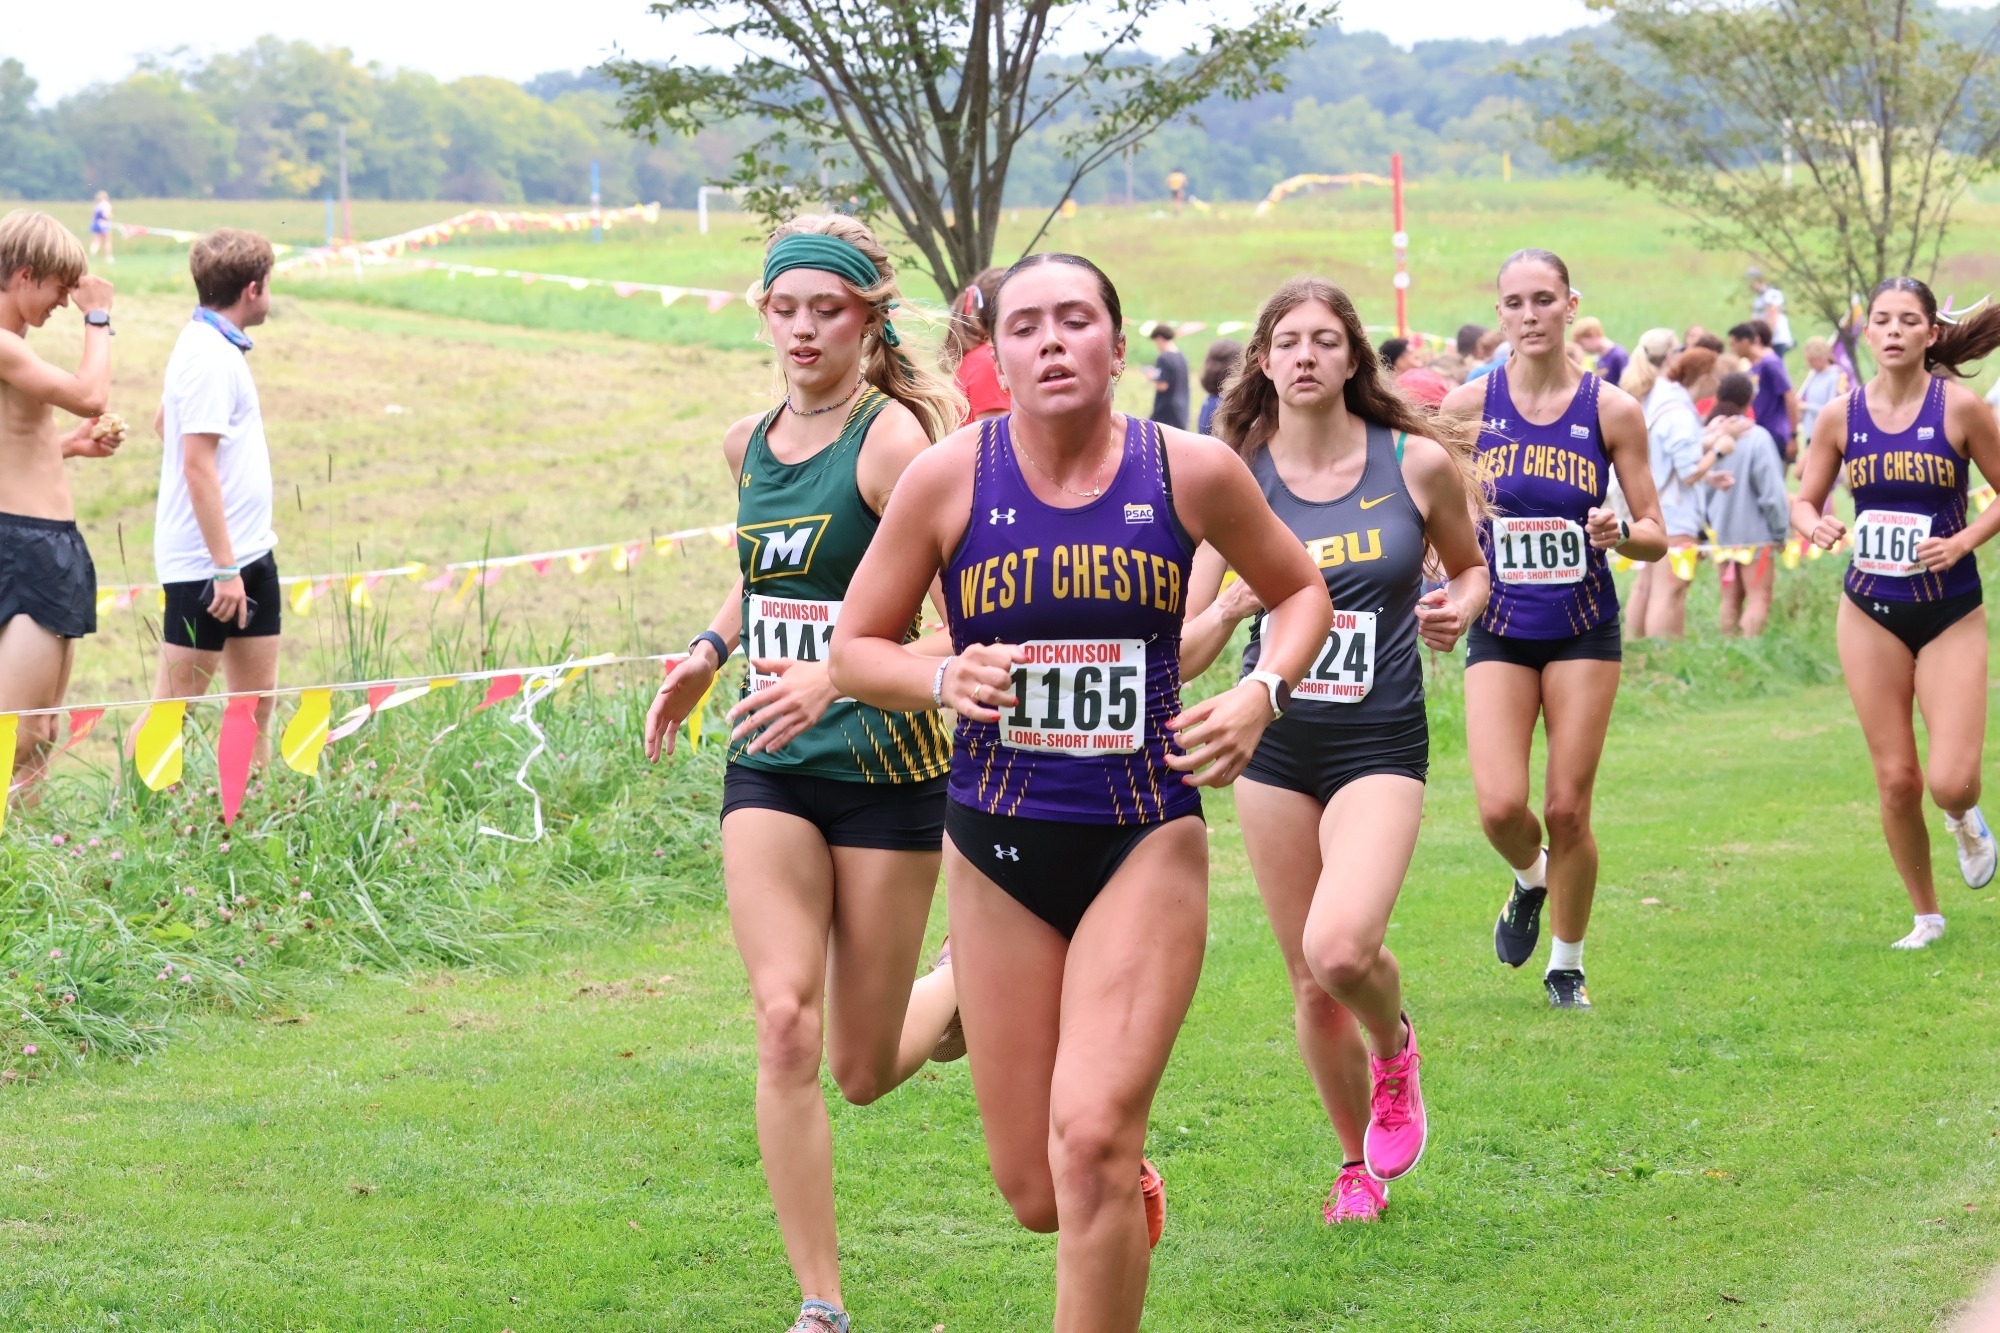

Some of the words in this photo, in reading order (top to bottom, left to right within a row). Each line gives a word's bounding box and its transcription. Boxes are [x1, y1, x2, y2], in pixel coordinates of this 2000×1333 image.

[1523, 444, 1598, 497] CHESTER
[1883, 451, 1956, 488] CHESTER
[1125, 509, 1154, 520] PSAC
[1868, 512, 1918, 526] DICKINSON
[1507, 520, 1567, 532] DICKINSON
[759, 527, 813, 571] M
[1500, 531, 1580, 569] 1169
[1858, 524, 1923, 564] 1166
[960, 547, 1039, 619] WEST
[1052, 544, 1181, 614] CHESTER
[1555, 568, 1580, 578] INVITE
[761, 600, 829, 622] DICKINSON
[1024, 643, 1121, 664] DICKINSON
[1008, 666, 1138, 731] 1165
[1332, 684, 1365, 697] INVITE
[1008, 730, 1089, 749] LONG-SHORT
[1092, 734, 1134, 749] INVITE
